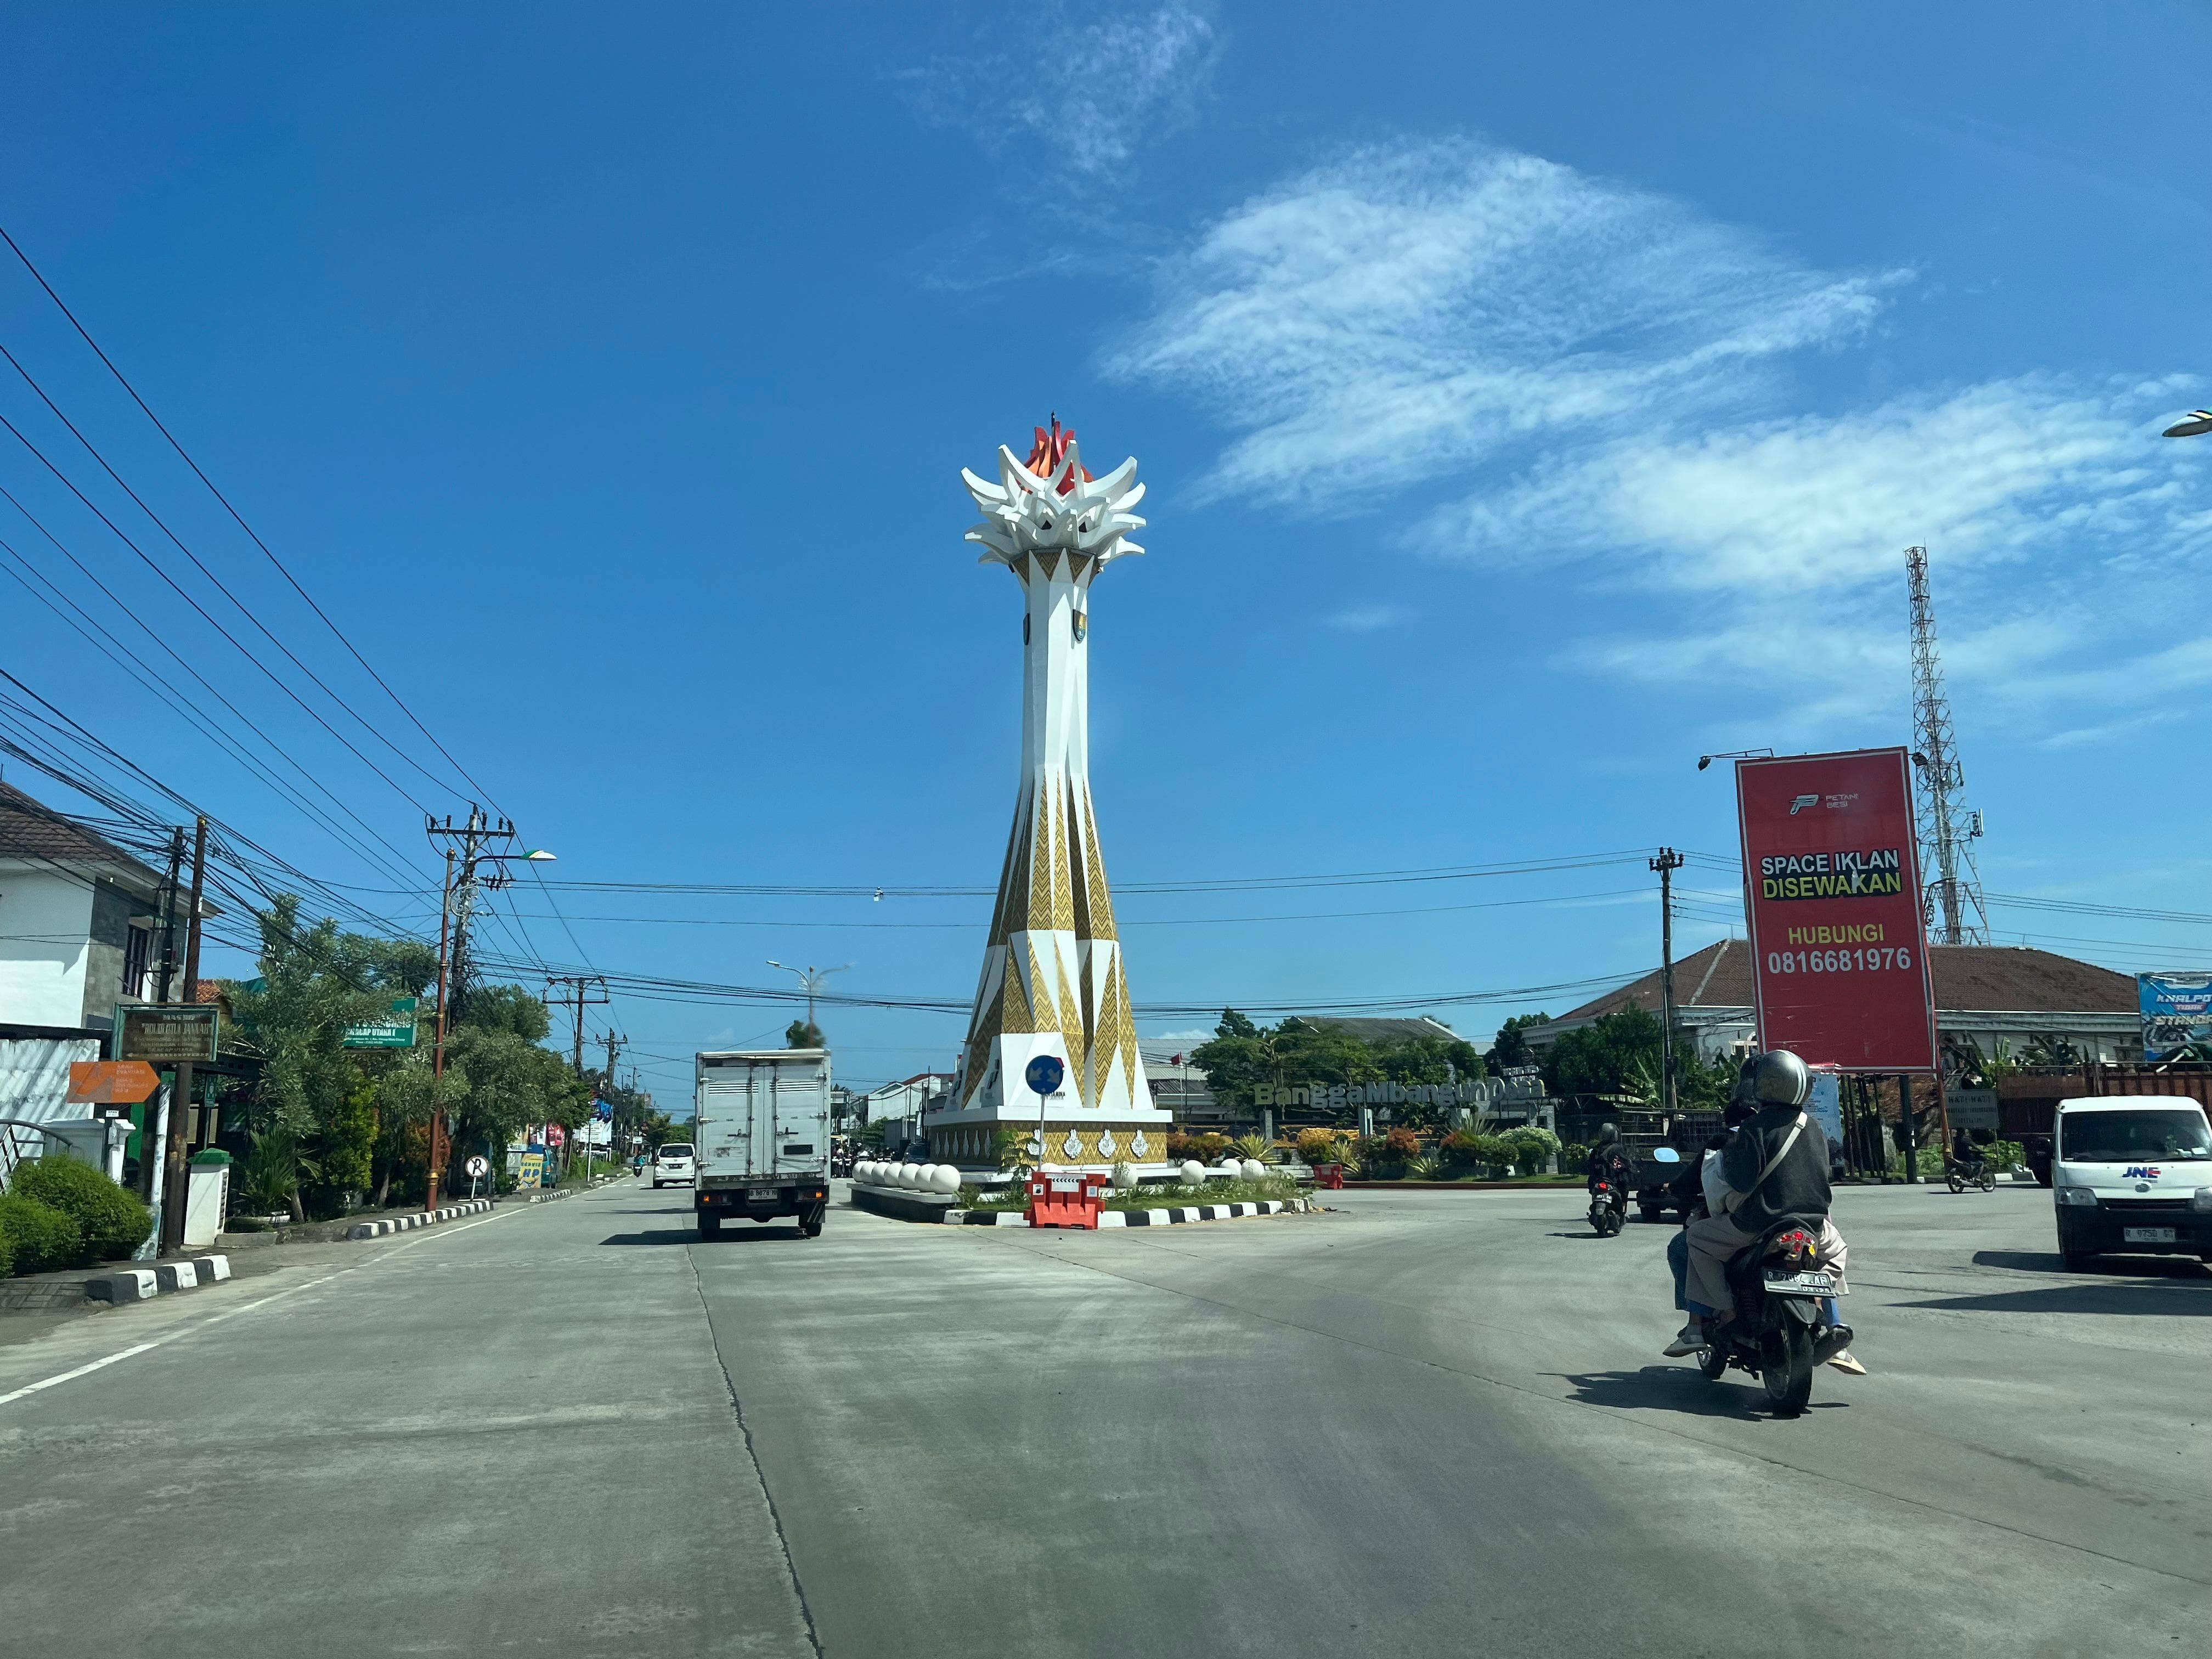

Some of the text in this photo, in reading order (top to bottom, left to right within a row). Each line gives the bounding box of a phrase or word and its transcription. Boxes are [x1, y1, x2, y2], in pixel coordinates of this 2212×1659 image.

[1761, 850, 1899, 876] SPACE IKLAN
[1763, 872, 1902, 899] DISEWAKAN
[1788, 924, 1884, 945] HUBUNGI
[1768, 947, 1911, 974] 0816681976
[1255, 1082, 1364, 1108] Bangga
[523, 1169, 540, 1178] HP
[2121, 1167, 2161, 1178] JNE
[1768, 1271, 1774, 1280] R
